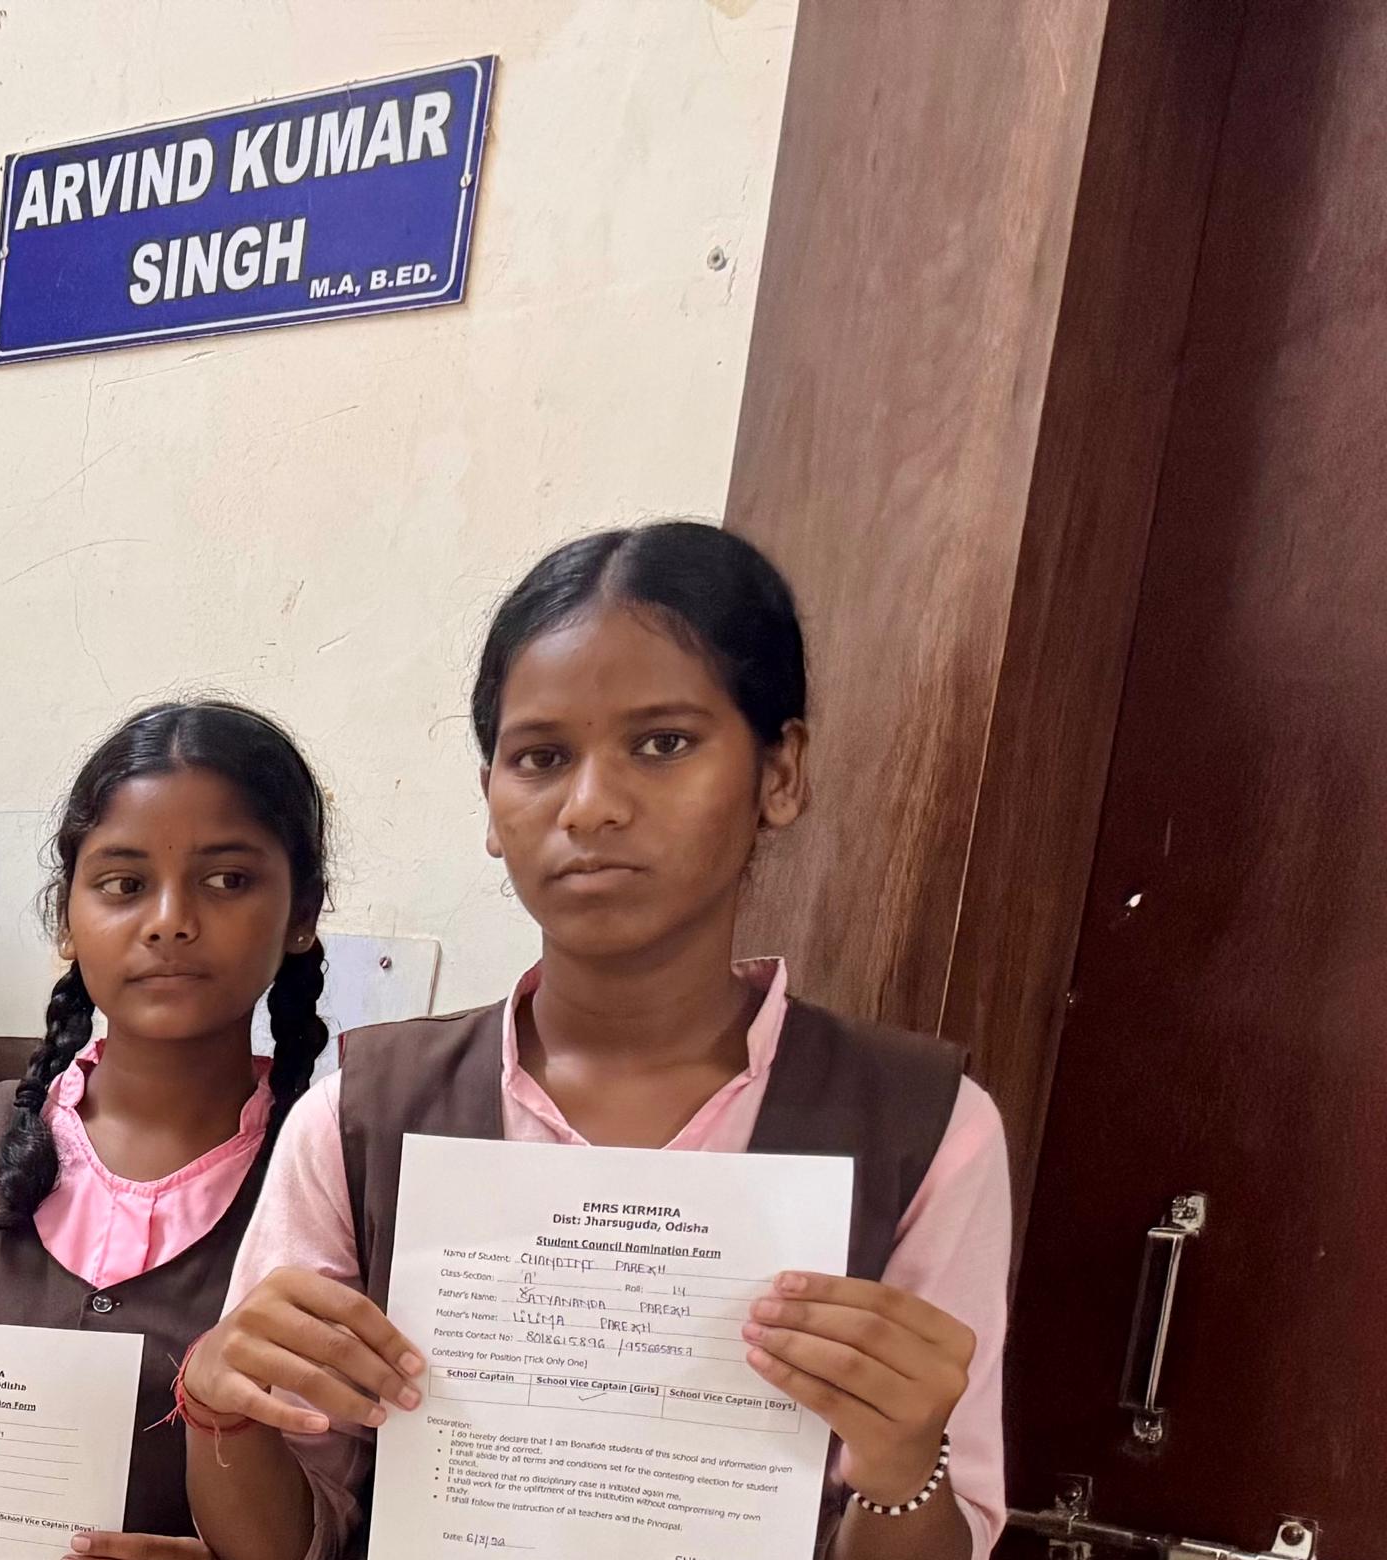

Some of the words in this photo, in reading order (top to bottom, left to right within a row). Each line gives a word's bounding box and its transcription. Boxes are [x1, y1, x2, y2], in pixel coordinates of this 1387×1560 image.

[13, 137, 213, 230] ARVIND
[229, 90, 451, 193] KUMAR
[128, 217, 306, 305] SINGH
[582, 1202, 619, 1214] EMRS
[622, 1204, 681, 1217] KIRMIRA
[553, 1213, 581, 1225] Dist:
[584, 1216, 661, 1232] Jharsuguda,
[665, 1221, 709, 1234] Odisha
[443, 1249, 466, 1259] Name
[536, 1236, 579, 1248] Student
[581, 1239, 623, 1252] Council
[625, 1243, 688, 1257] Nomination
[692, 1247, 721, 1259] Form
[438, 1288, 468, 1300] Father's
[471, 1292, 497, 1302] Name:
[436, 1308, 469, 1320] Mother's
[471, 1311, 498, 1321] Name:
[434, 1328, 463, 1338] Parents
[466, 1330, 496, 1340] Contact
[432, 1347, 474, 1360] Contesting
[476, 1350, 487, 1359] for
[490, 1352, 521, 1362] Position
[546, 1356, 565, 1367] Only
[447, 1369, 477, 1379] School
[479, 1372, 514, 1383] Captain
[536, 1376, 567, 1386] School
[569, 1378, 588, 1388] Vice
[591, 1380, 627, 1392] Captain
[629, 1384, 659, 1396] [Girls]
[14, 1402, 36, 1411] Form
[669, 1389, 701, 1400] School
[703, 1393, 723, 1403] Vice
[725, 1395, 762, 1408] Captain
[764, 1399, 797, 1411] [Boys]
[427, 1416, 472, 1430] Declaration:
[469, 1431, 497, 1442] hereby
[499, 1434, 529, 1445] declare
[530, 1437, 547, 1446] that
[608, 1445, 643, 1455] students
[655, 1449, 670, 1459] this
[672, 1452, 699, 1463] school
[700, 1457, 716, 1466] and
[719, 1459, 767, 1471] information
[769, 1465, 793, 1474] given
[476, 1443, 493, 1451] true
[494, 1444, 510, 1452] and
[610, 1463, 622, 1472] set
[637, 1467, 651, 1476] the
[501, 1472, 517, 1481] that
[578, 1480, 598, 1489] case
[508, 1483, 522, 1492] the
[636, 1498, 666, 1509] without
[727, 1511, 740, 1521] my
[0, 1513, 23, 1523] School
[24, 1518, 40, 1526] Vice
[42, 1519, 69, 1530] Captain
[496, 1501, 510, 1510] the
[512, 1503, 554, 1514] instruction
[579, 1509, 613, 1520] teachers
[615, 1514, 630, 1523] and
[632, 1516, 645, 1525] the
